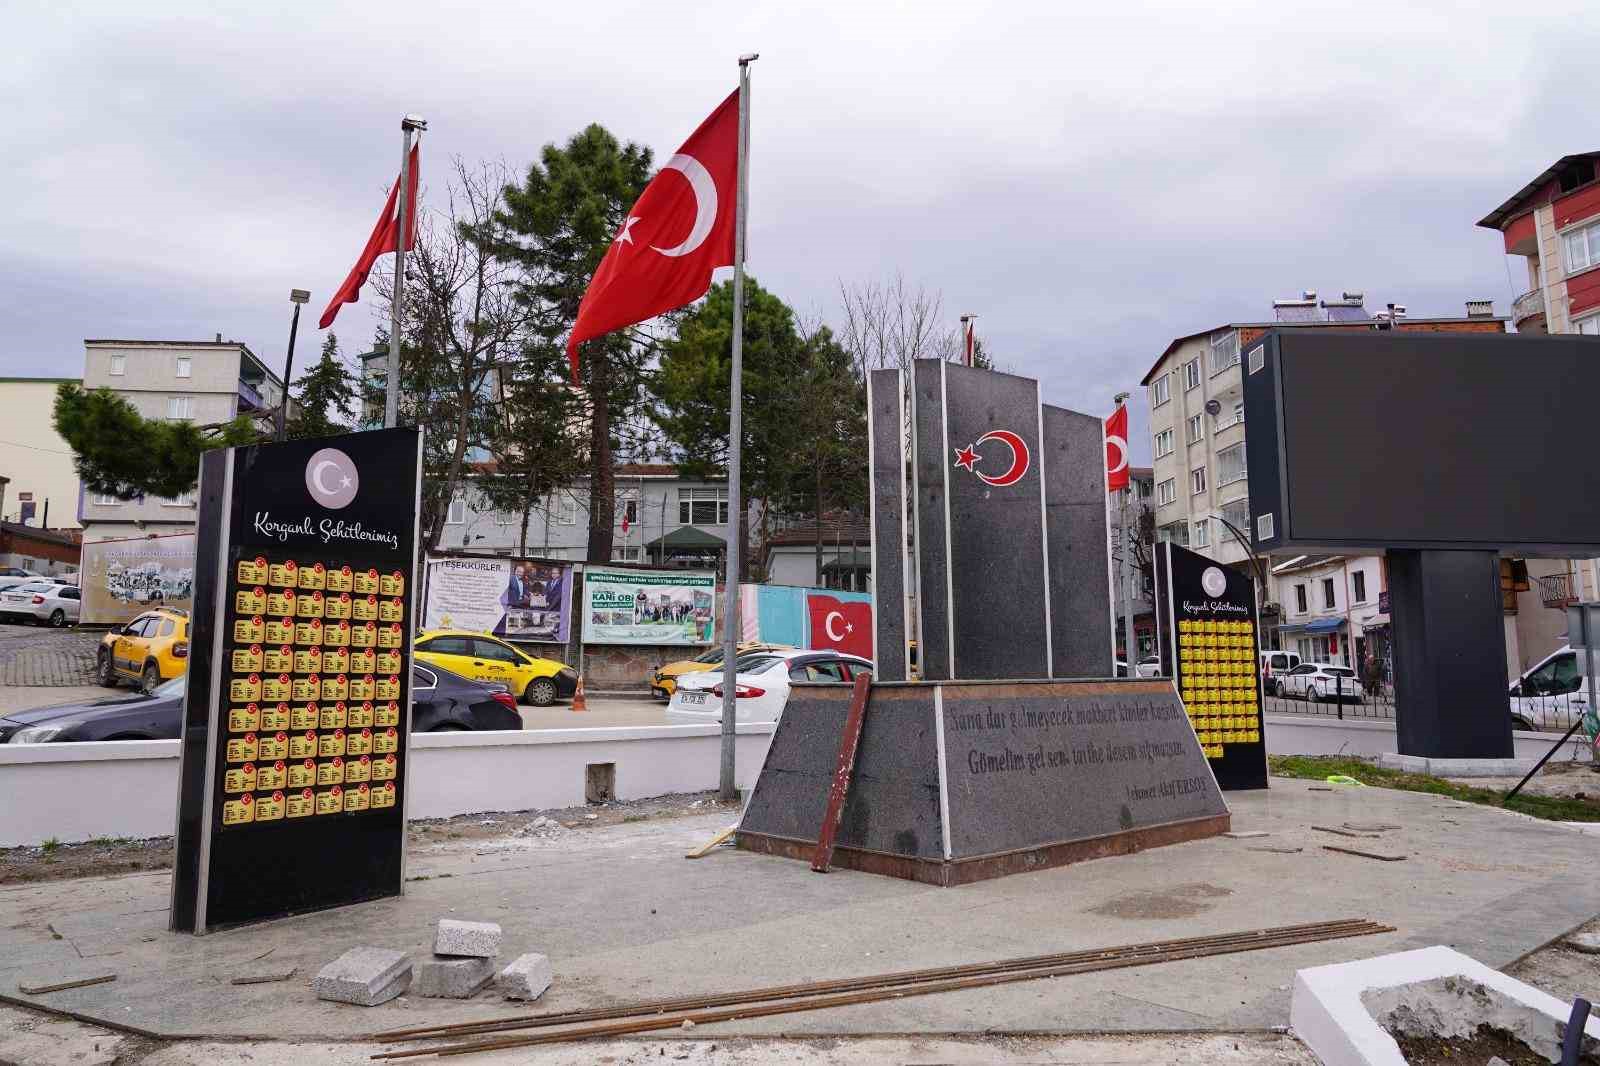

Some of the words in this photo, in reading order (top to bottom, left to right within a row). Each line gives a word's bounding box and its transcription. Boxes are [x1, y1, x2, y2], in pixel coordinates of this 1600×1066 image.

[254, 511, 317, 542] Korganlı
[319, 518, 399, 549] Şehitlerimiz
[986, 705, 1008, 729] dar
[968, 747, 1026, 775] Gömelim
[1027, 745, 1046, 776] gel
